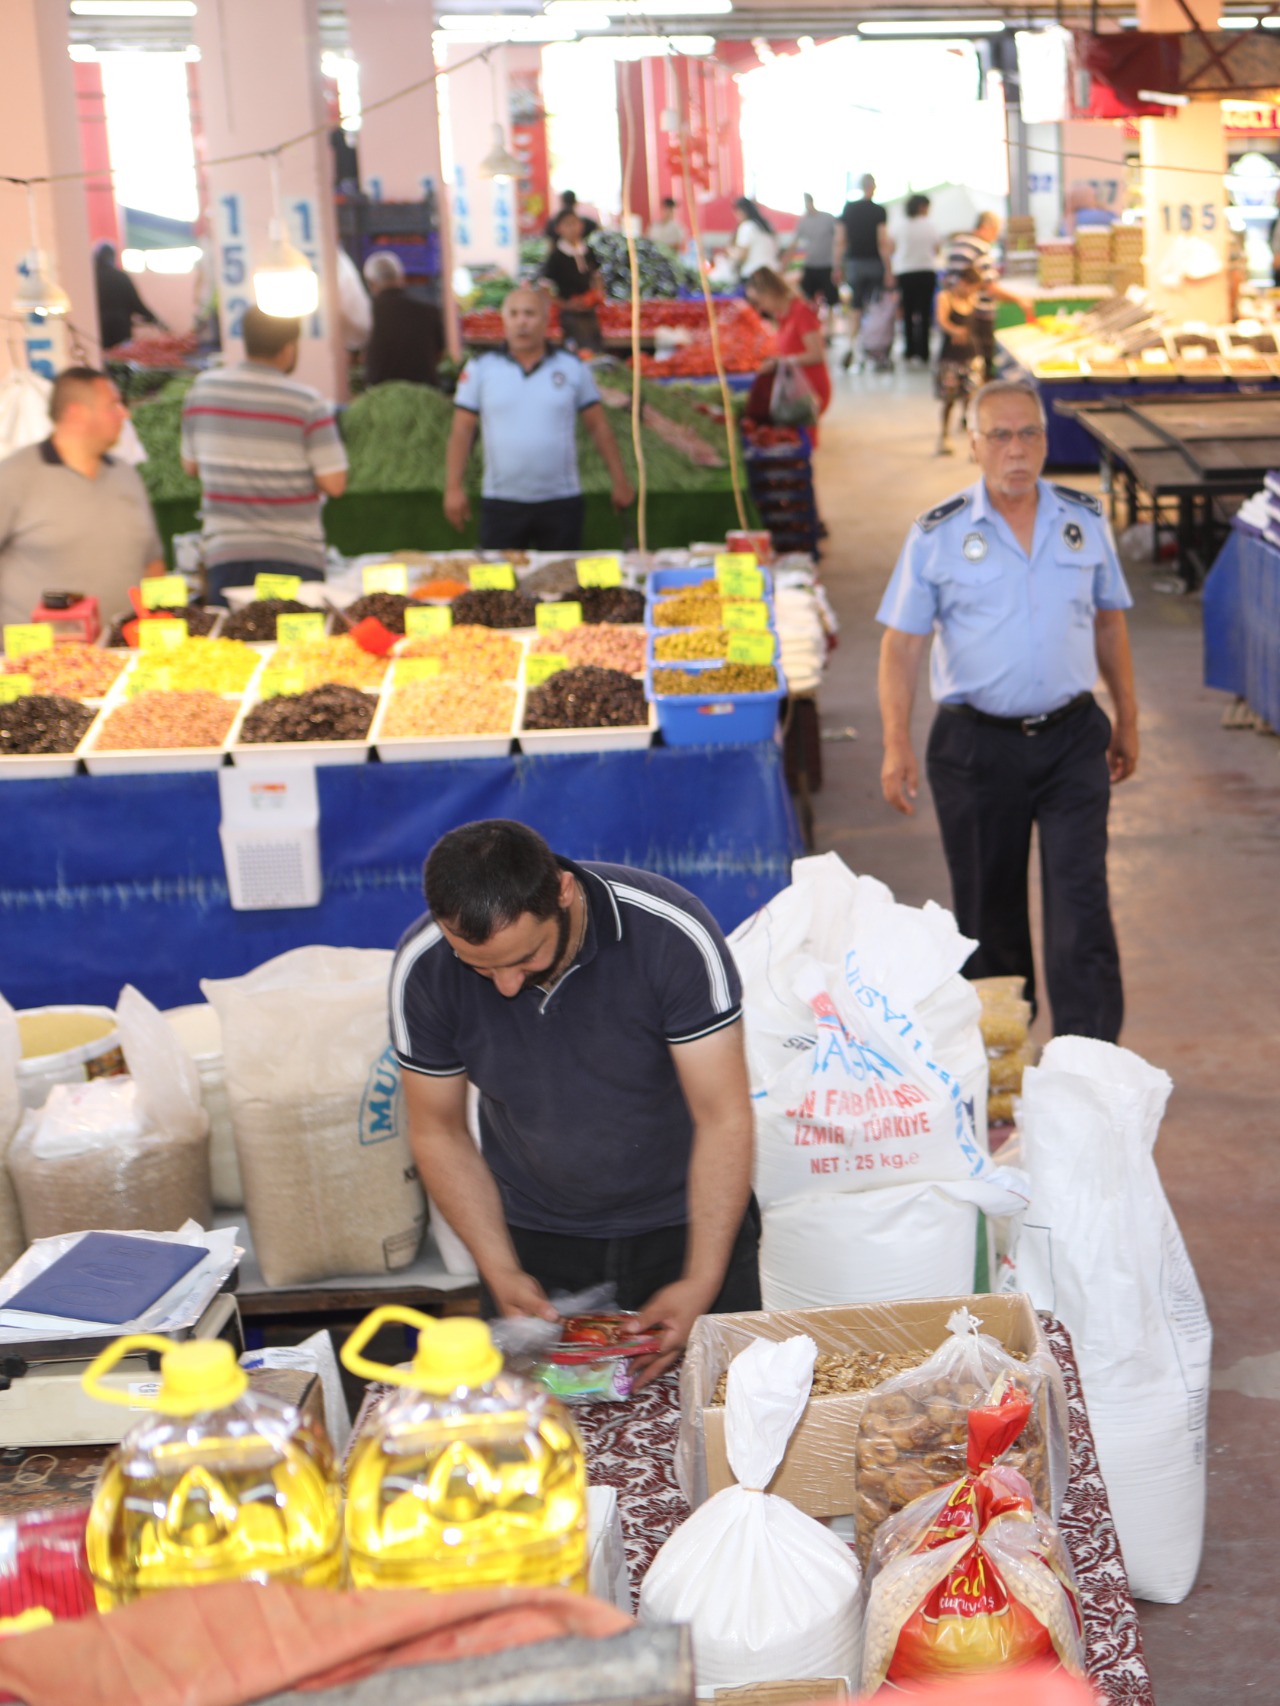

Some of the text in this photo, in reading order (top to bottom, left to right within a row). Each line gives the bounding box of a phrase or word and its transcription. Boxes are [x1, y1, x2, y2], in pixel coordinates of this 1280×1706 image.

[1161, 205, 1217, 231] 165
[794, 1120, 845, 1147] İZMİR
[863, 1111, 931, 1143] TÜRKİYE
[810, 1156, 840, 1175] NET
[855, 1154, 875, 1171] 25
